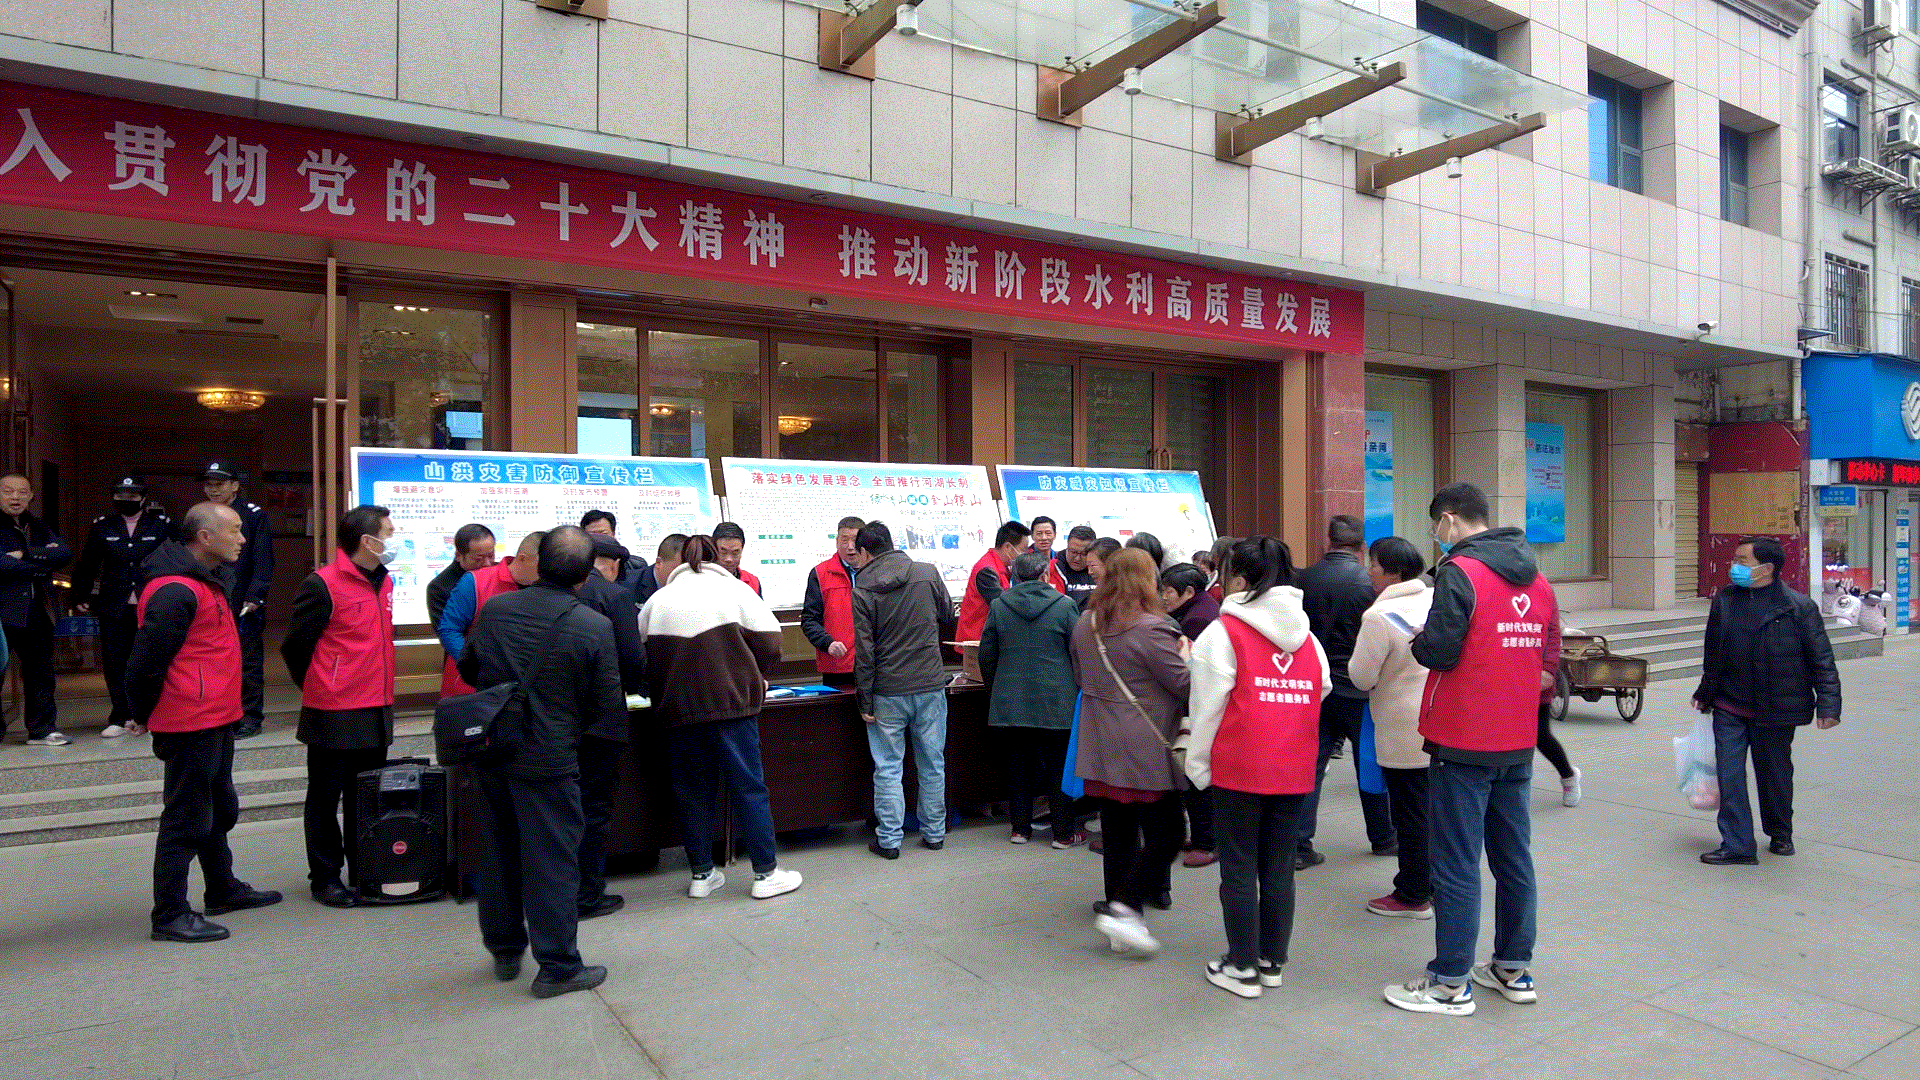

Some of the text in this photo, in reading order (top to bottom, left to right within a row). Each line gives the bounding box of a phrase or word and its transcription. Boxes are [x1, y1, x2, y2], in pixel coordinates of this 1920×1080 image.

[0, 107, 1333, 340] 入贯彻党的二十大精神 推动新阶段水利高质量发展
[424, 461, 654, 485] 山洪灾害防御宣传栏
[751, 472, 968, 489] 落实绿色发展理念 全面推行河湖长制
[1037, 475, 1170, 493] 防灾减灾知识宣传栏
[1254, 676, 1314, 691] 新时代文明实践
[1258, 691, 1311, 705] 志愿者服务队
